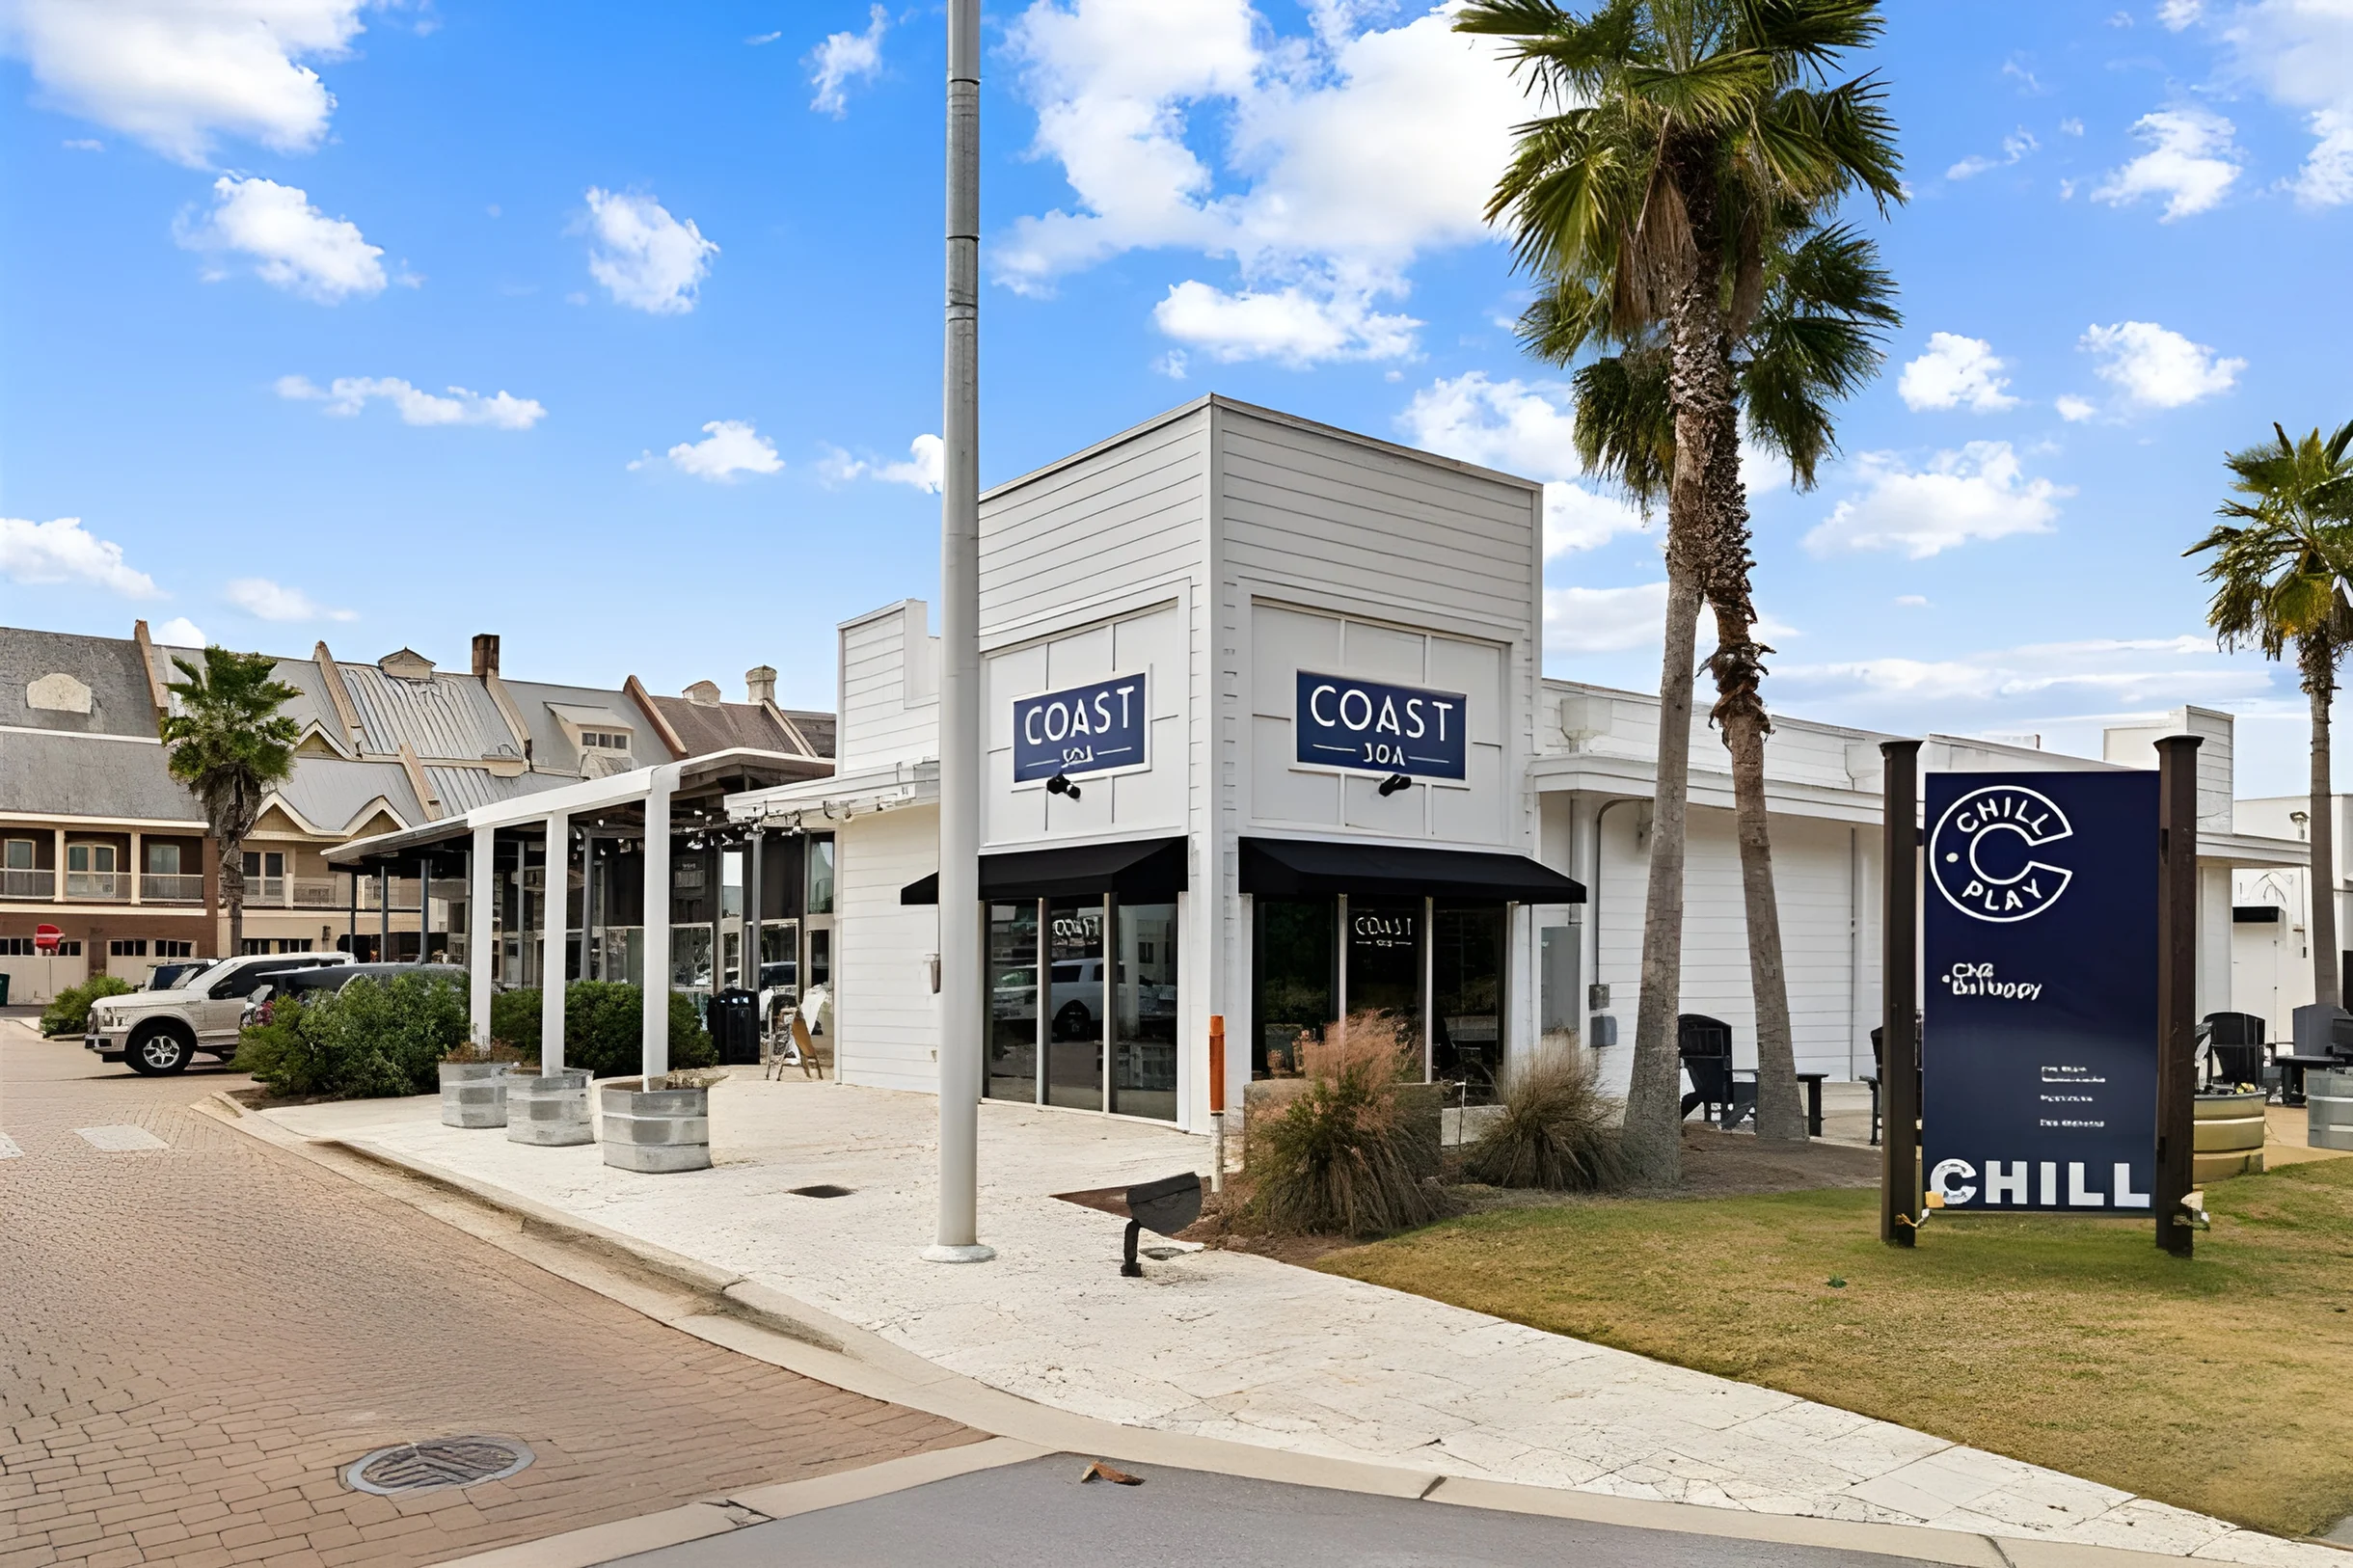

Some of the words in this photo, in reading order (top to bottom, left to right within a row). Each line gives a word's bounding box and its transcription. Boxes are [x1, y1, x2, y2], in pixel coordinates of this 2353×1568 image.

[1024, 686, 1135, 745] COAST
[1310, 684, 1454, 743] COAST
[1956, 796, 2049, 836] CHILL
[1961, 879, 2042, 911] PLAY
[1930, 1157, 2150, 1208] CHILL
